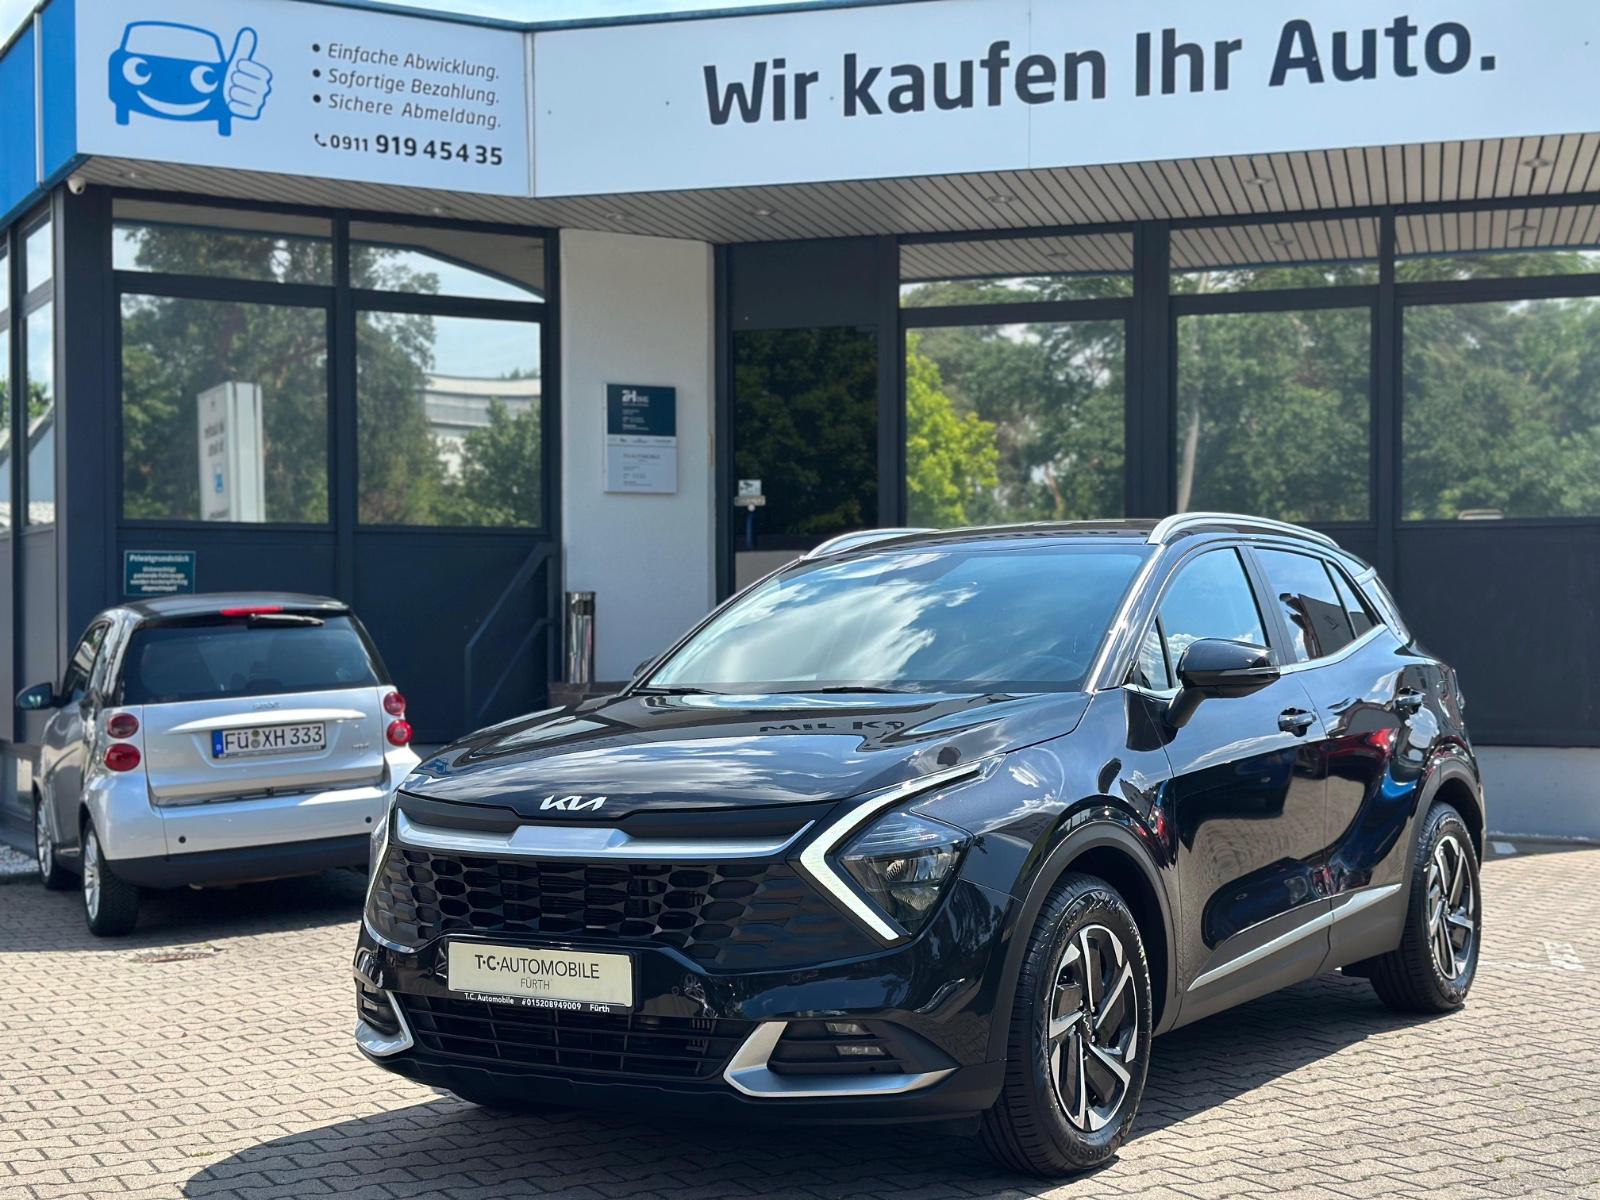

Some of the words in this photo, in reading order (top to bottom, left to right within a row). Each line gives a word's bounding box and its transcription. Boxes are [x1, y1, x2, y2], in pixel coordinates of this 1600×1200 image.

[328, 43, 399, 66] Einfache
[403, 53, 499, 82] Abwicklung.
[703, 58, 819, 125] Wir
[843, 40, 1106, 117] kaufen
[1135, 28, 1243, 97] Ihr
[1268, 15, 1496, 87] Auto.
[328, 68, 405, 94] Sofortige
[411, 78, 499, 106] Bezahlung.
[328, 93, 393, 115] Sichere
[402, 102, 502, 130] Abmeldung.
[330, 134, 368, 152] 0911
[375, 134, 417, 157] 919
[262, 728, 285, 748] XH
[290, 726, 323, 745] 333
[539, 795, 607, 811] KIA
[520, 977, 550, 990] FÜRTH
[477, 994, 514, 1005] Automobile
[589, 1003, 611, 1013] Fürth
